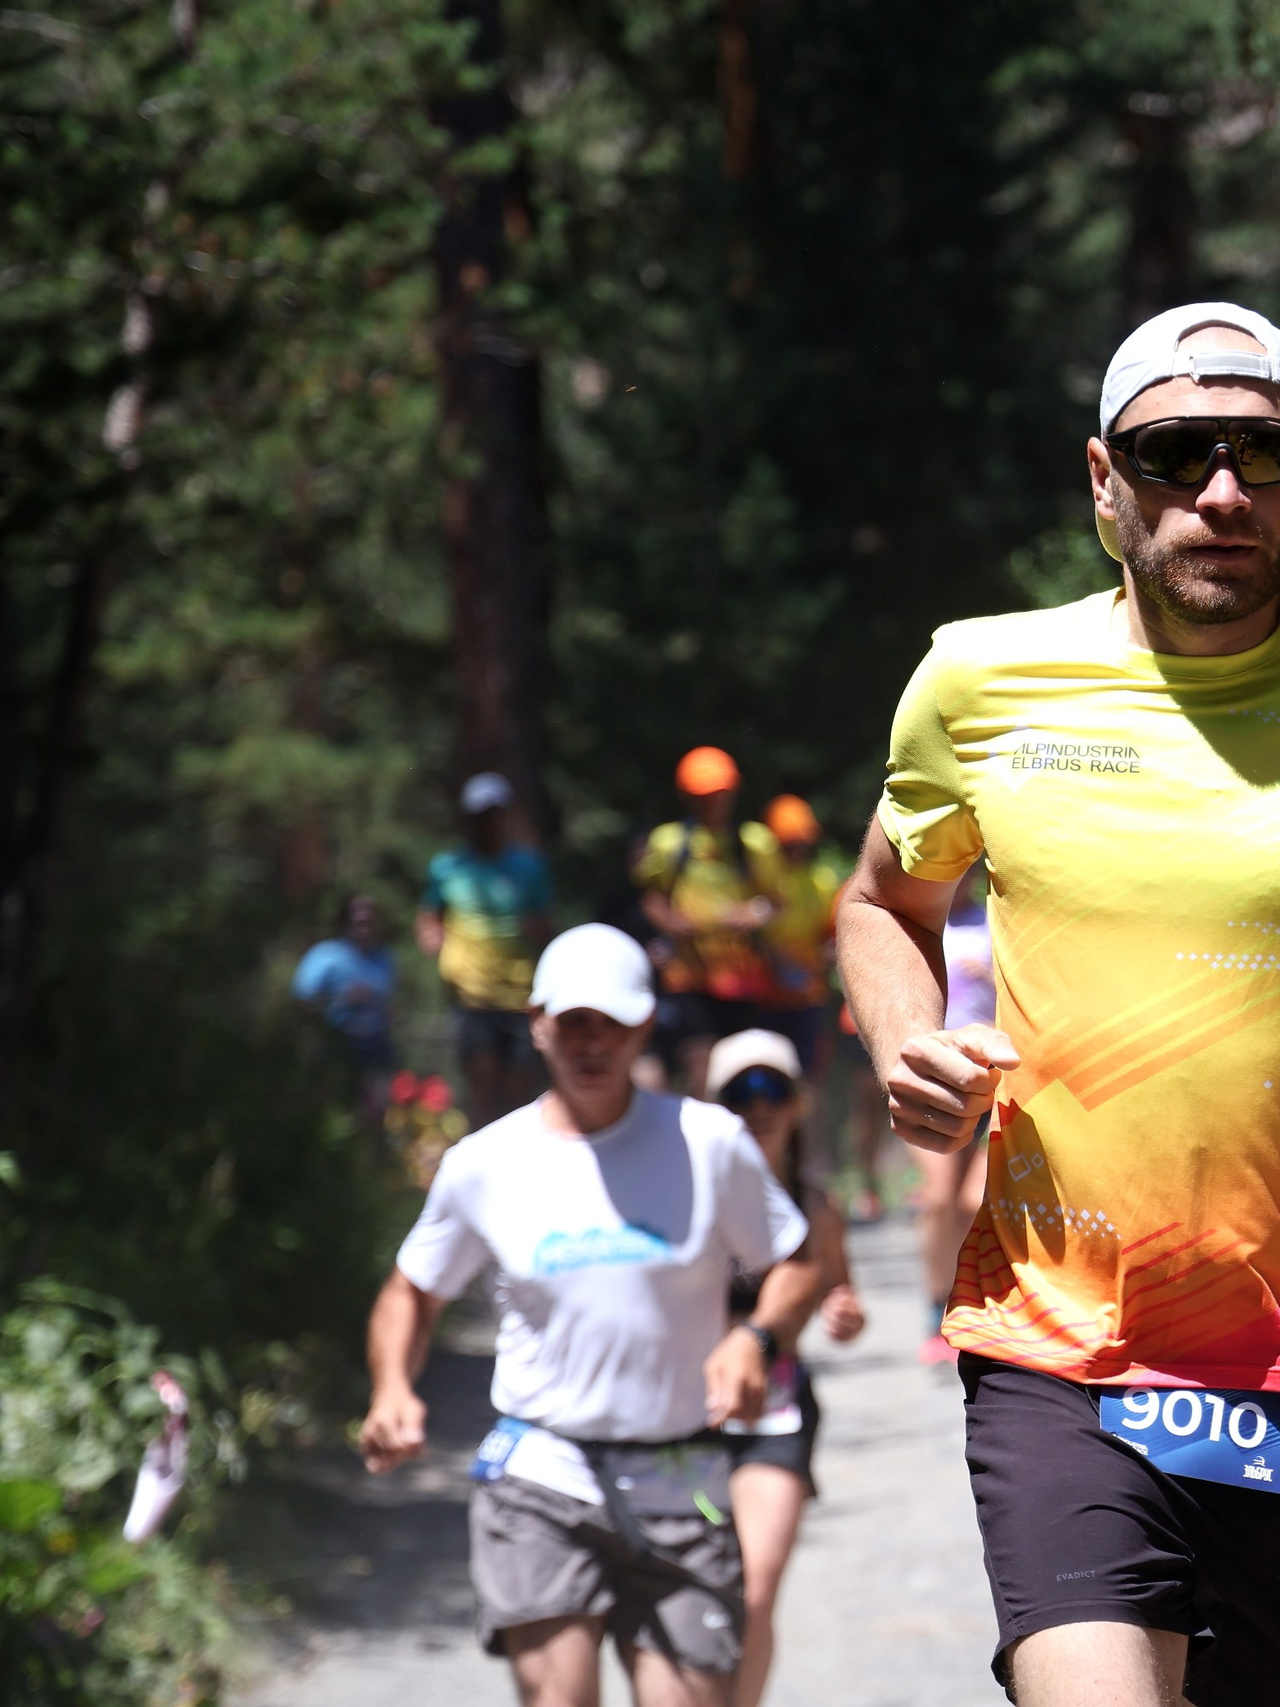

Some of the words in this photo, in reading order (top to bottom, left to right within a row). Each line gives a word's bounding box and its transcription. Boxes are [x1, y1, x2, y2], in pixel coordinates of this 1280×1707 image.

[1011, 757, 1081, 772] ELBRUS
[1090, 760, 1141, 773] RACE
[1121, 1386, 1268, 1449] 9010
[1056, 1570, 1096, 1582] EVADICT
